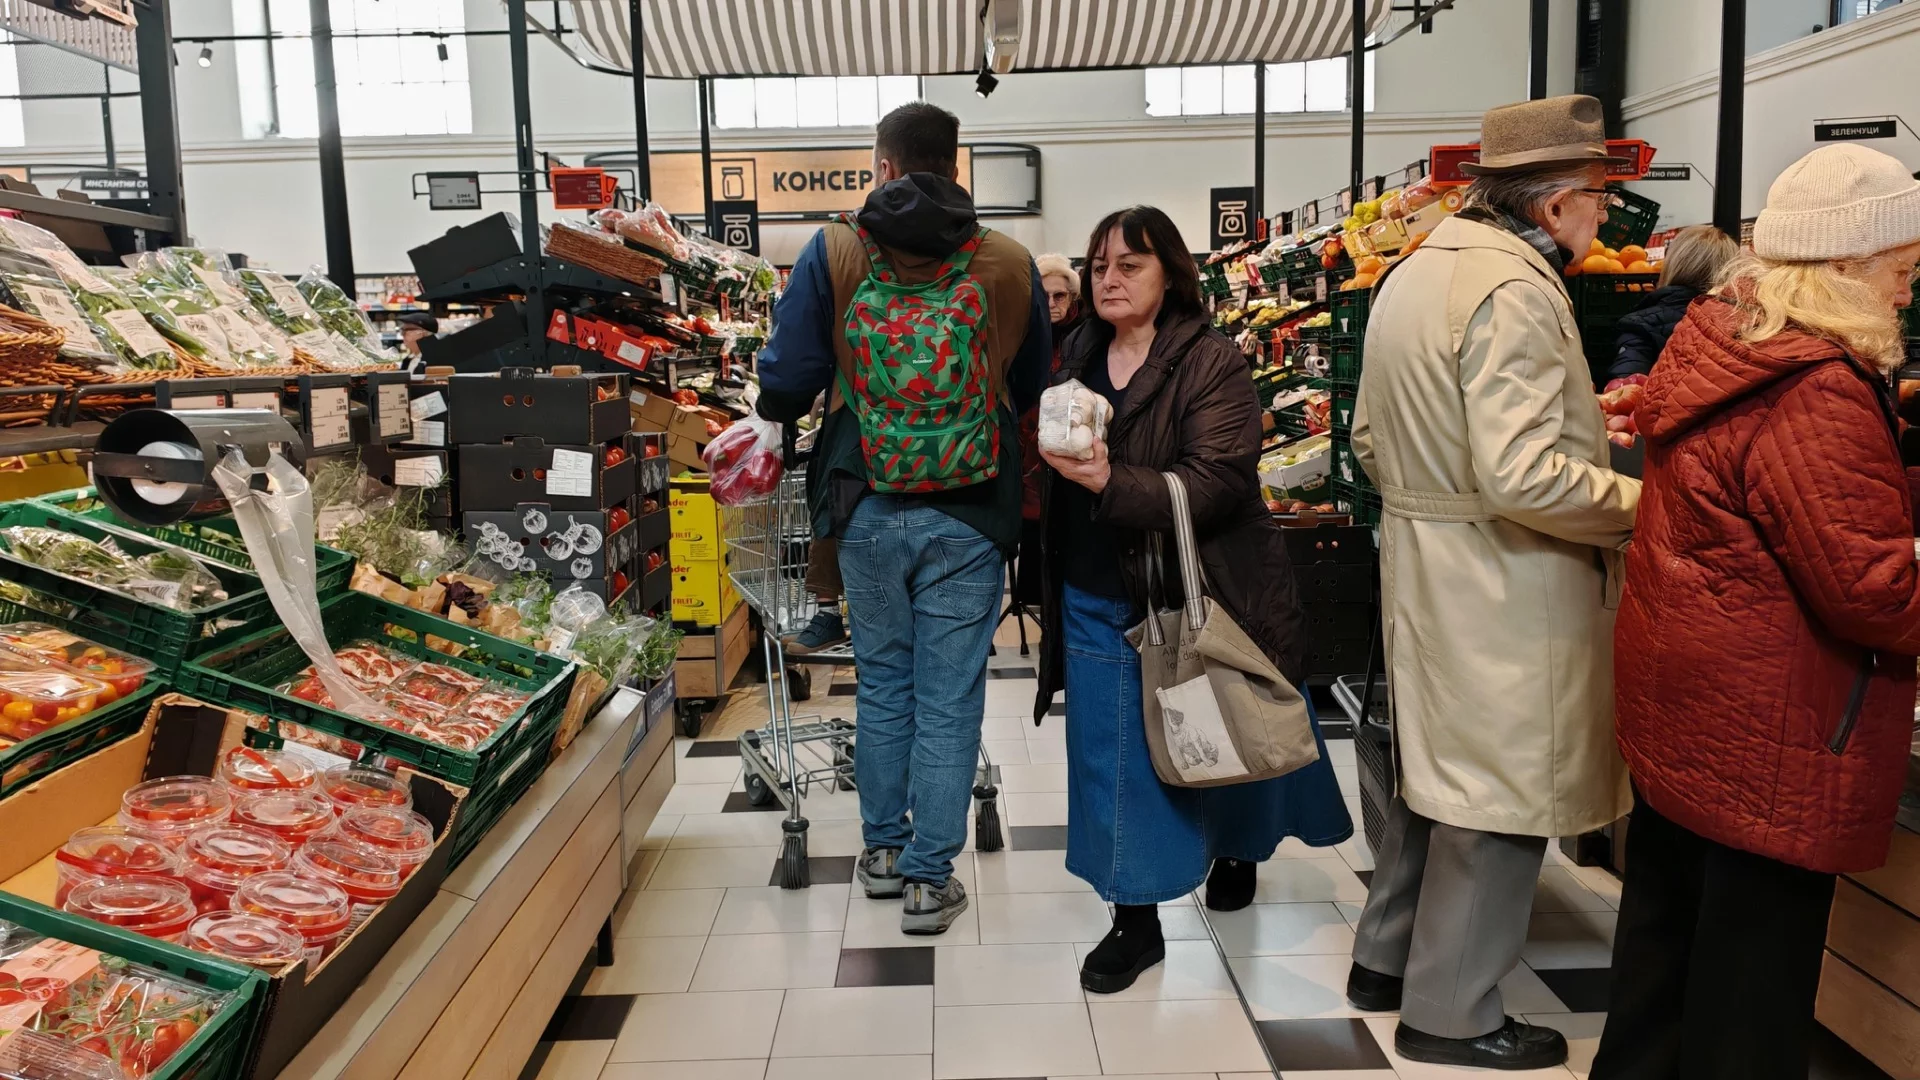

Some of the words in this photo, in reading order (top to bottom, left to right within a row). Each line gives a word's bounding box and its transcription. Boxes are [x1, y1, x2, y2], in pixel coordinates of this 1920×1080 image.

[1830, 126, 1880, 137] ЗЕЛЕНЧУЦИ
[85, 179, 136, 188] ИНСТАНТНИ
[136, 180, 148, 188] СУ
[773, 170, 873, 192] КОНСЕР
[1183, 649, 1200, 661] dog
